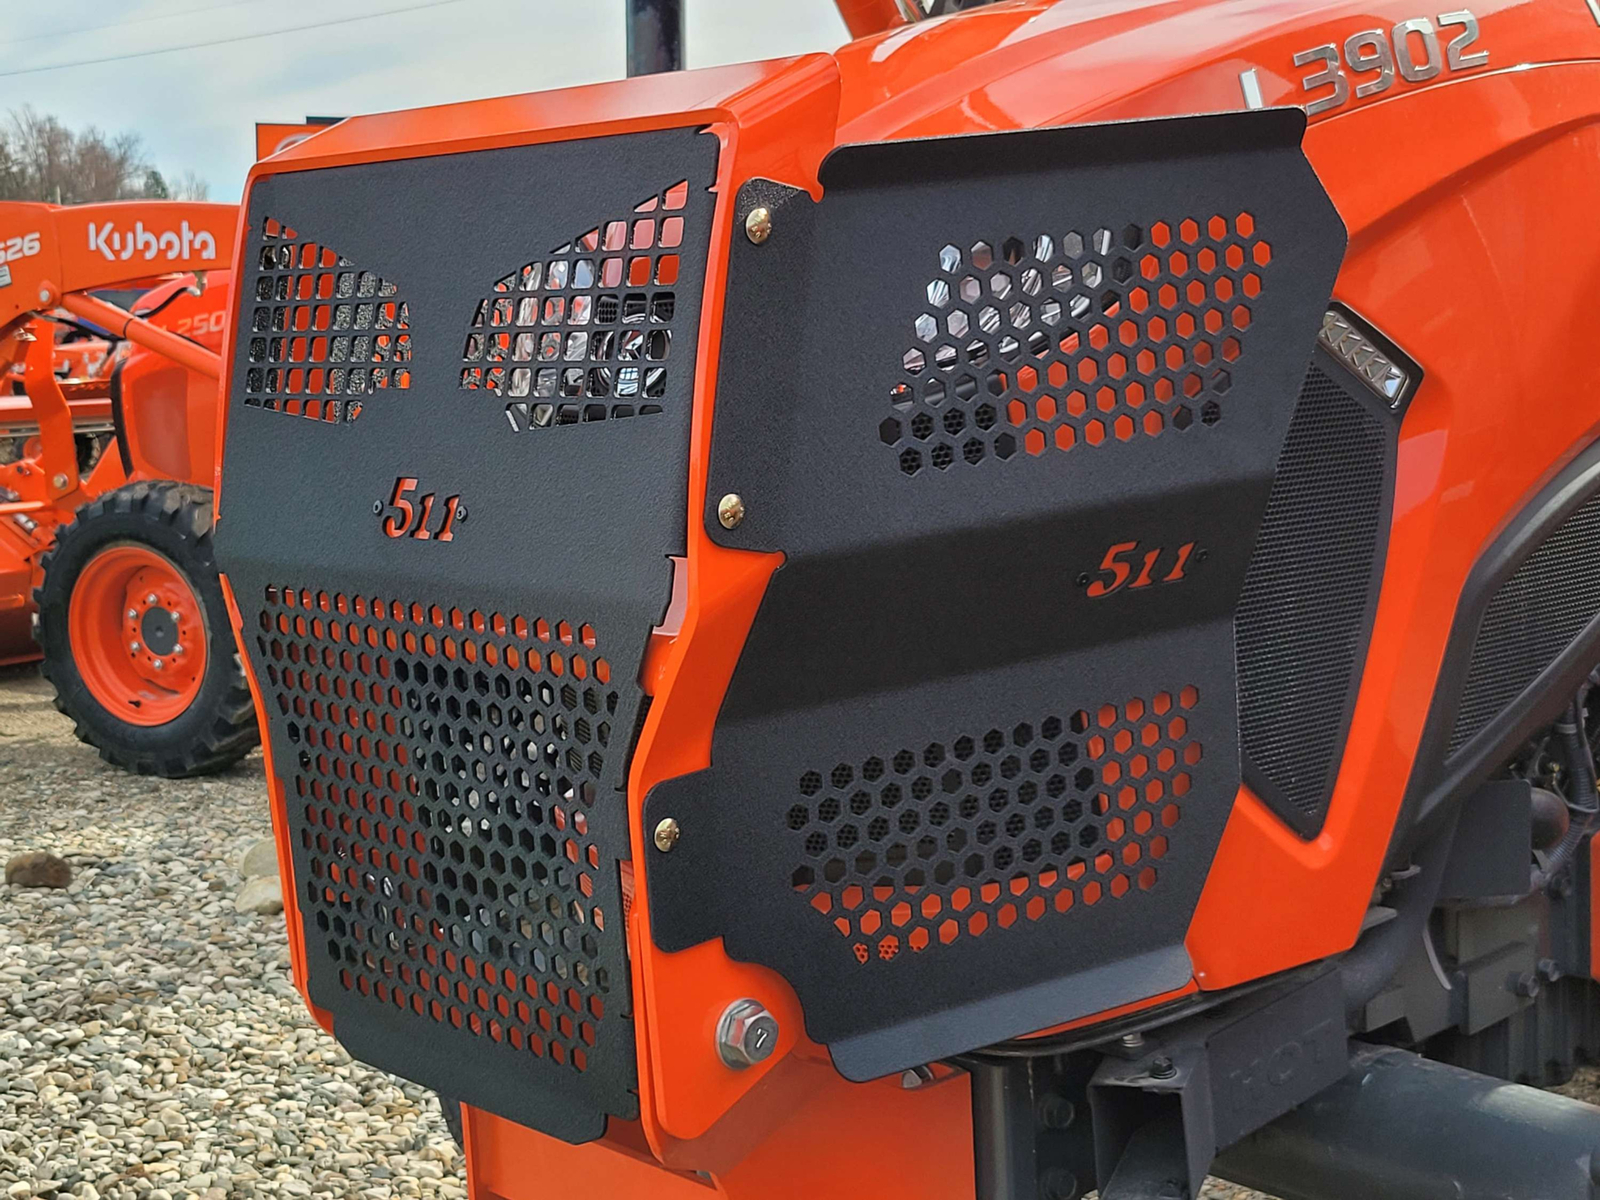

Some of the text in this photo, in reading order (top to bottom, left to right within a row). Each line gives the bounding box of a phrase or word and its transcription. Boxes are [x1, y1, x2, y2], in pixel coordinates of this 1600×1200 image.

[88, 220, 216, 261] Kubota
[382, 476, 460, 542] 511
[1086, 540, 1197, 597] 511
